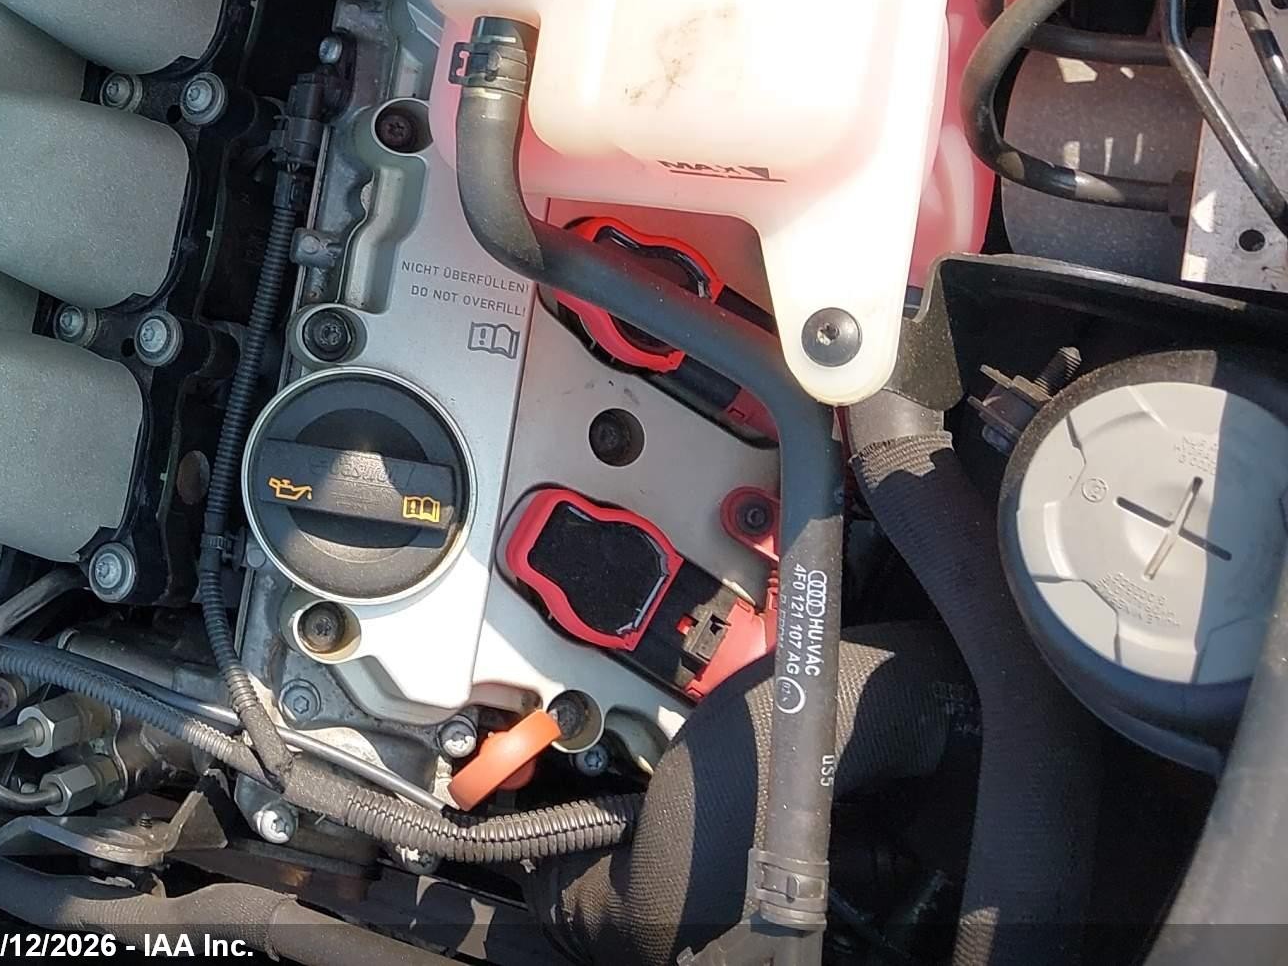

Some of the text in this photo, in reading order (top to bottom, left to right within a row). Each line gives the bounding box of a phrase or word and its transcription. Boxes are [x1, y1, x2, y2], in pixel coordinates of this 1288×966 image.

[656, 160, 742, 175] MAX
[401, 260, 529, 293] NICHT ÜBERFÜLLEN!
[411, 284, 526, 317] DO NOT OVERFILL!
[792, 563, 807, 591] 4F0
[791, 594, 805, 619] 121
[788, 623, 803, 649] 107
[785, 650, 801, 675] AG
